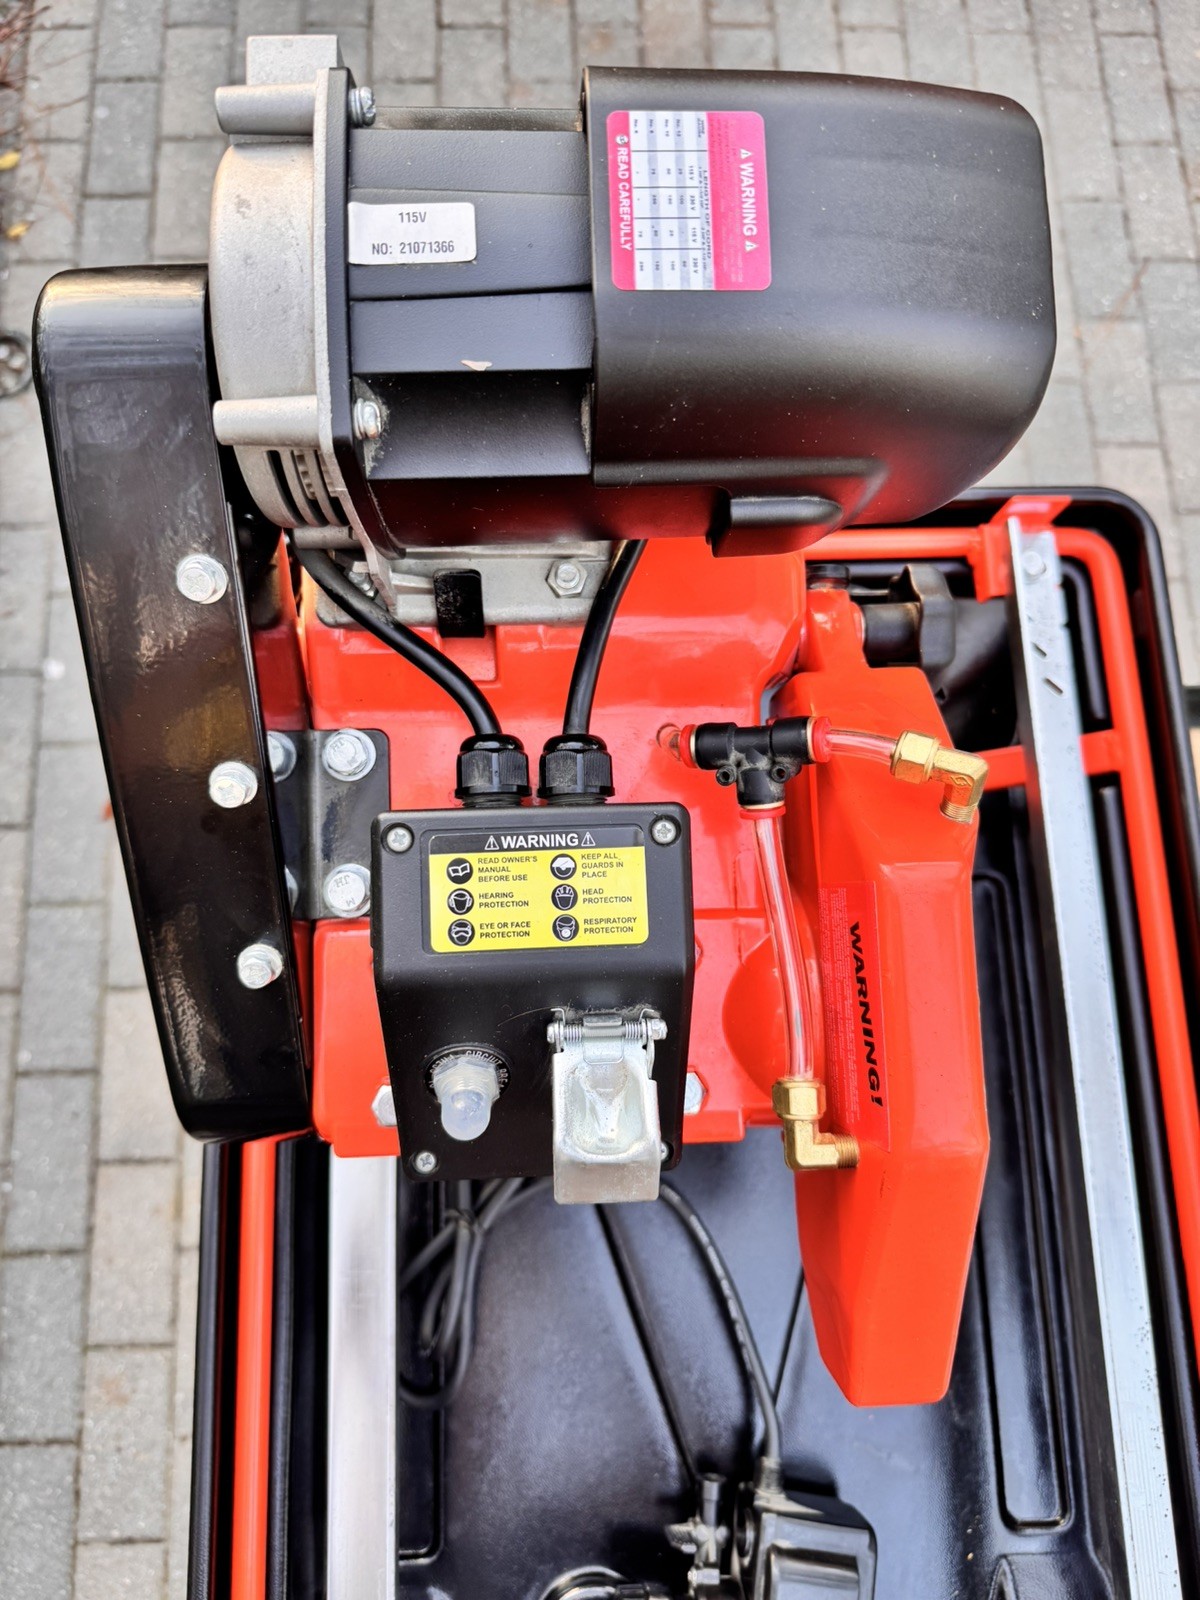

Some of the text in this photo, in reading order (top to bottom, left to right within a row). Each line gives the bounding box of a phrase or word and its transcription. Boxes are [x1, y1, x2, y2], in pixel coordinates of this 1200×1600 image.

[617, 148, 632, 251] READ CAREFULLY
[740, 162, 758, 236] WARNING
[398, 212, 427, 223] 115V
[705, 213, 710, 226] OF
[372, 240, 454, 255] NO: 21071366
[501, 833, 579, 849] WARNING
[479, 900, 529, 908] PROTECTION
[583, 896, 632, 904] PROTECTION
[584, 917, 637, 925] RESPIRATORY
[480, 930, 530, 938] PROTECTION
[584, 926, 634, 934] PROTECTION
[849, 922, 883, 1107] WARNING!
[465, 1050, 502, 1065] CIRCUIT
